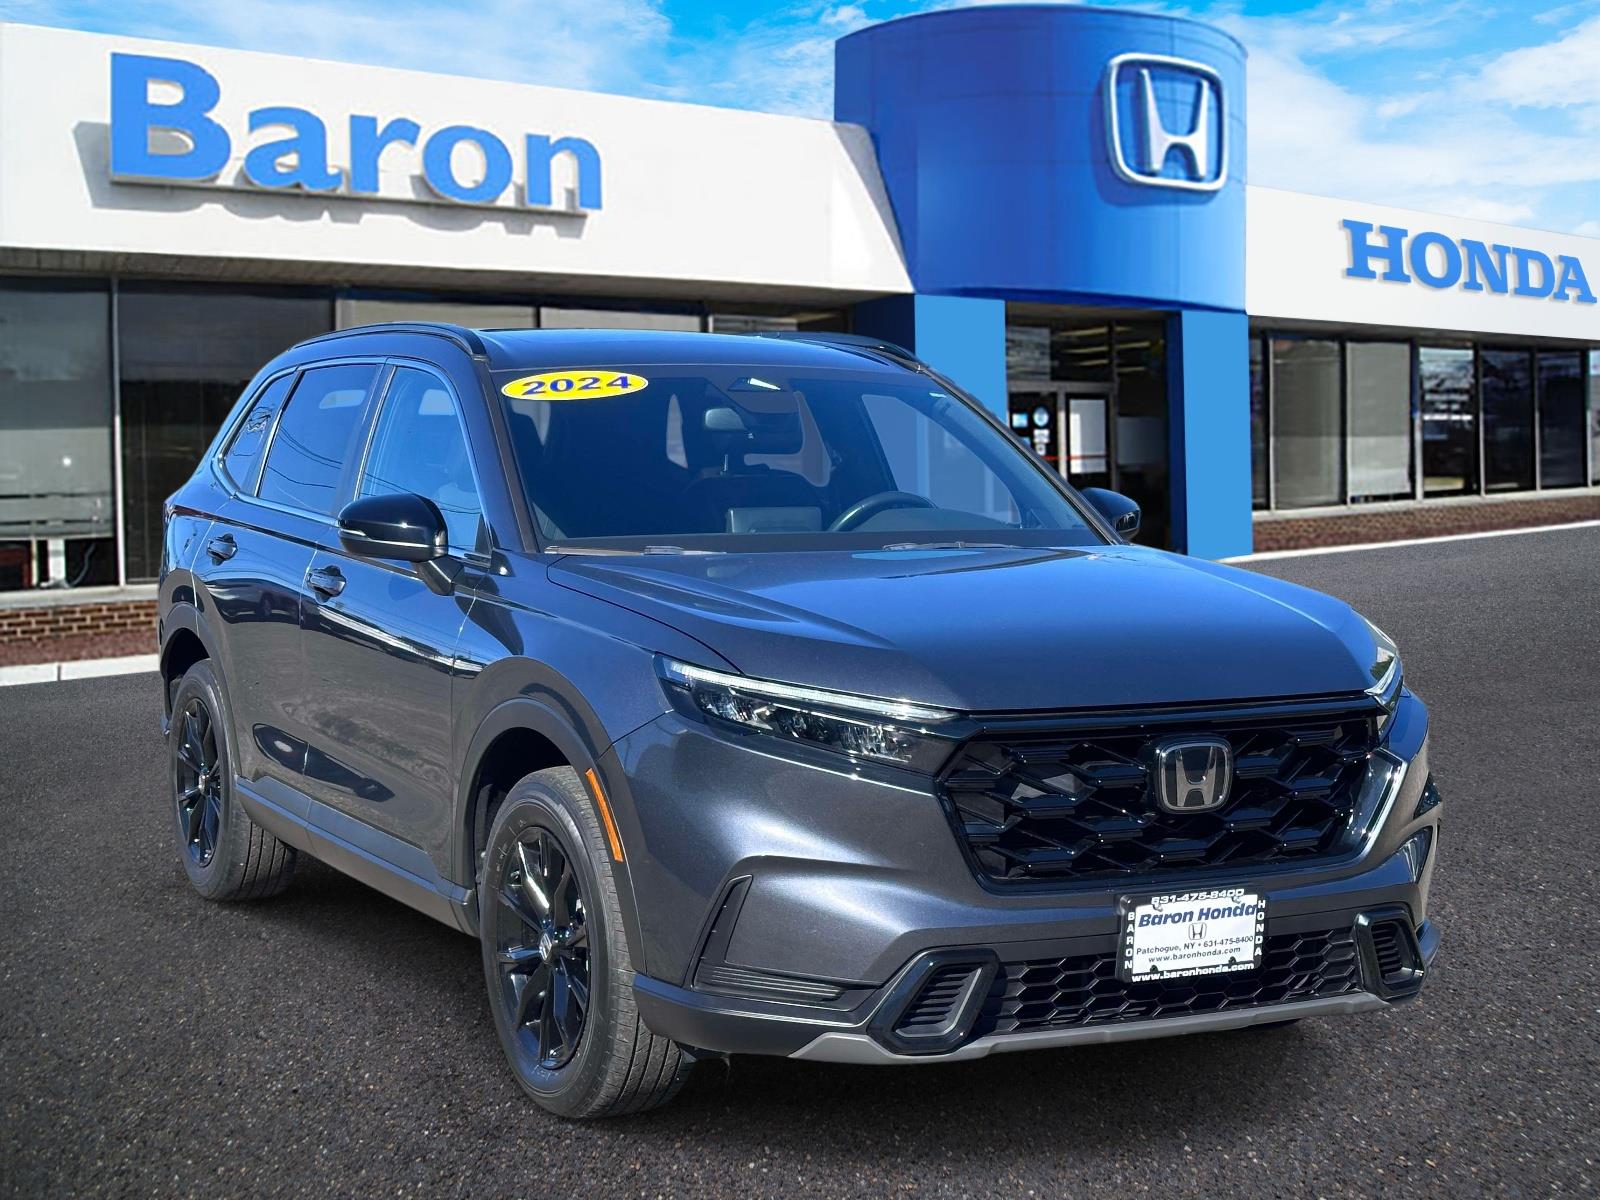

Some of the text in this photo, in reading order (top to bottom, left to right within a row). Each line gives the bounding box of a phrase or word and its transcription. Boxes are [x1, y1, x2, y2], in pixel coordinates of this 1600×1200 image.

[110, 52, 603, 210] Baron
[1342, 218, 1598, 304] HONDA
[522, 376, 631, 395] 2024
[1151, 888, 1245, 905] 631-475-8400
[1138, 902, 1257, 928] Baron Honda
[1136, 935, 1254, 955] Patchogue, NY 631-475-8400
[1148, 946, 1241, 963] www.baronhonda.com
[1132, 962, 1255, 983] www.baronhonda.com
